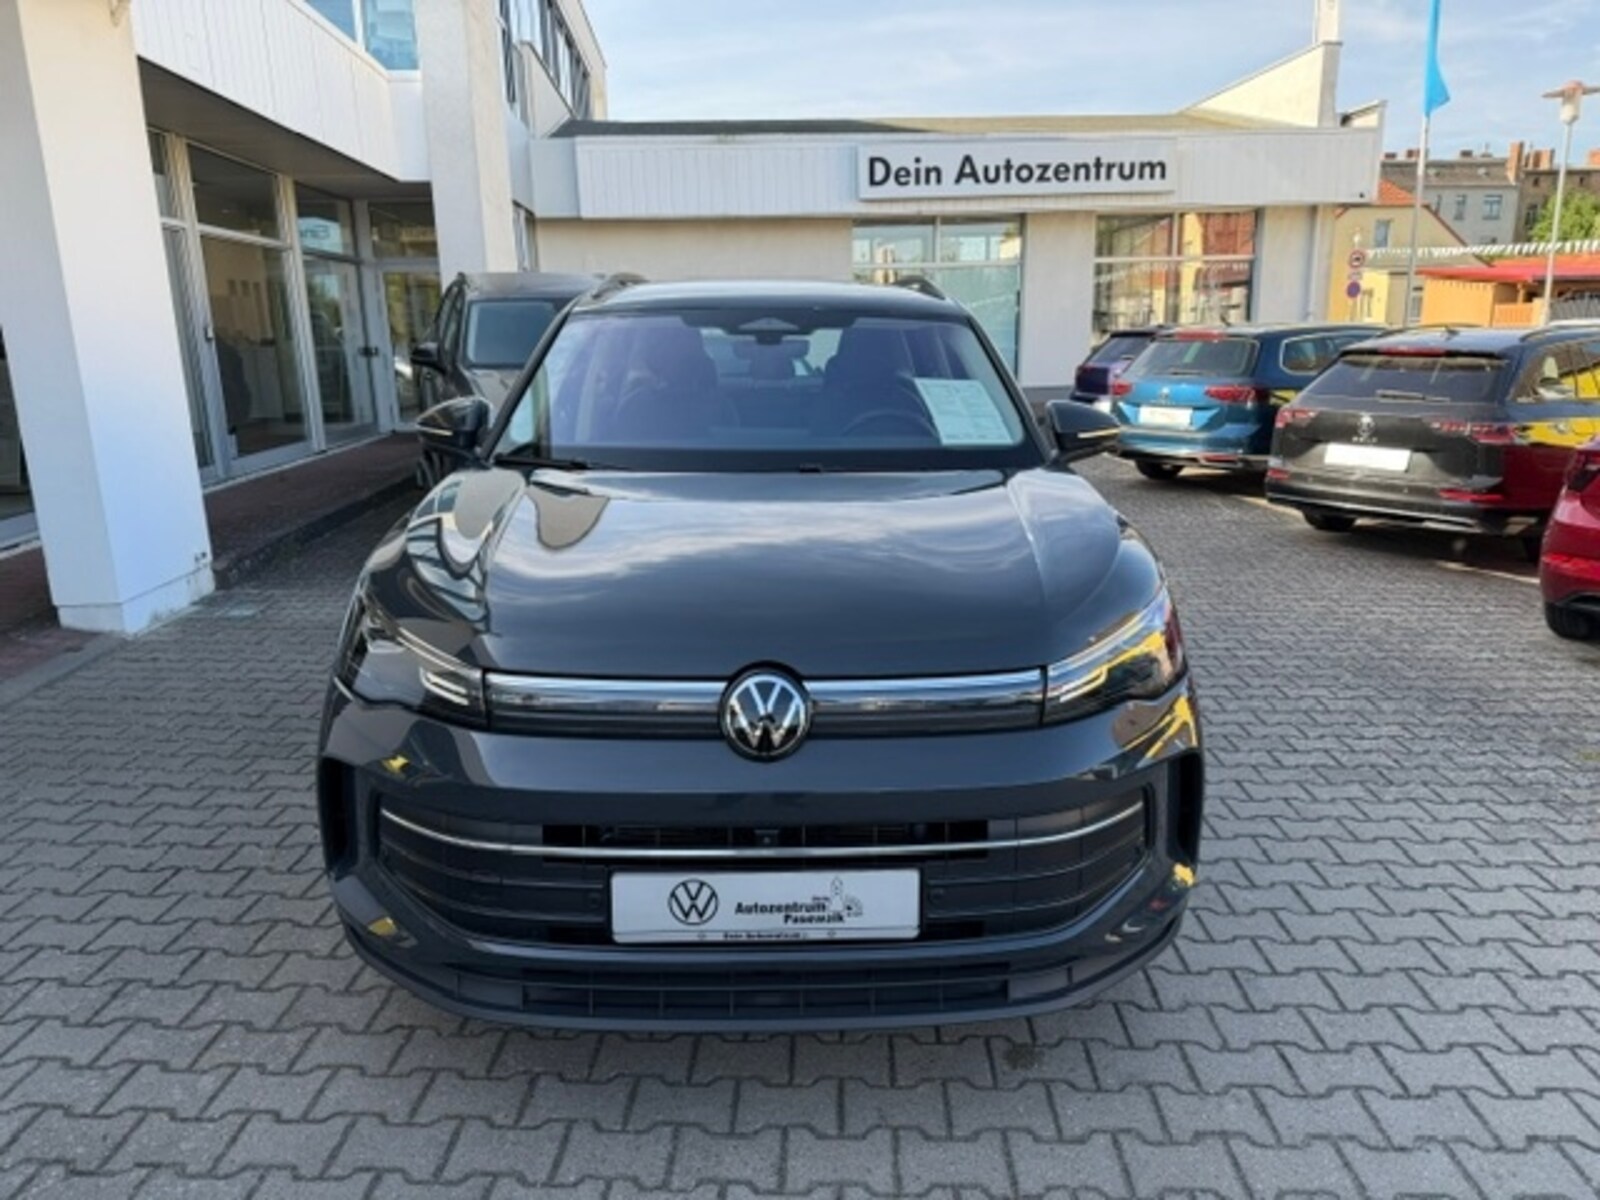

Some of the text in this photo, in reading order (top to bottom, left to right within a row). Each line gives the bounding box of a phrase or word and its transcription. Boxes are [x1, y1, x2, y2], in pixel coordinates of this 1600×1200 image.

[868, 154, 1167, 187] Dein Autozentrum
[726, 673, 806, 756] VW
[667, 878, 719, 926] VW
[735, 901, 827, 915] Autozentrum
